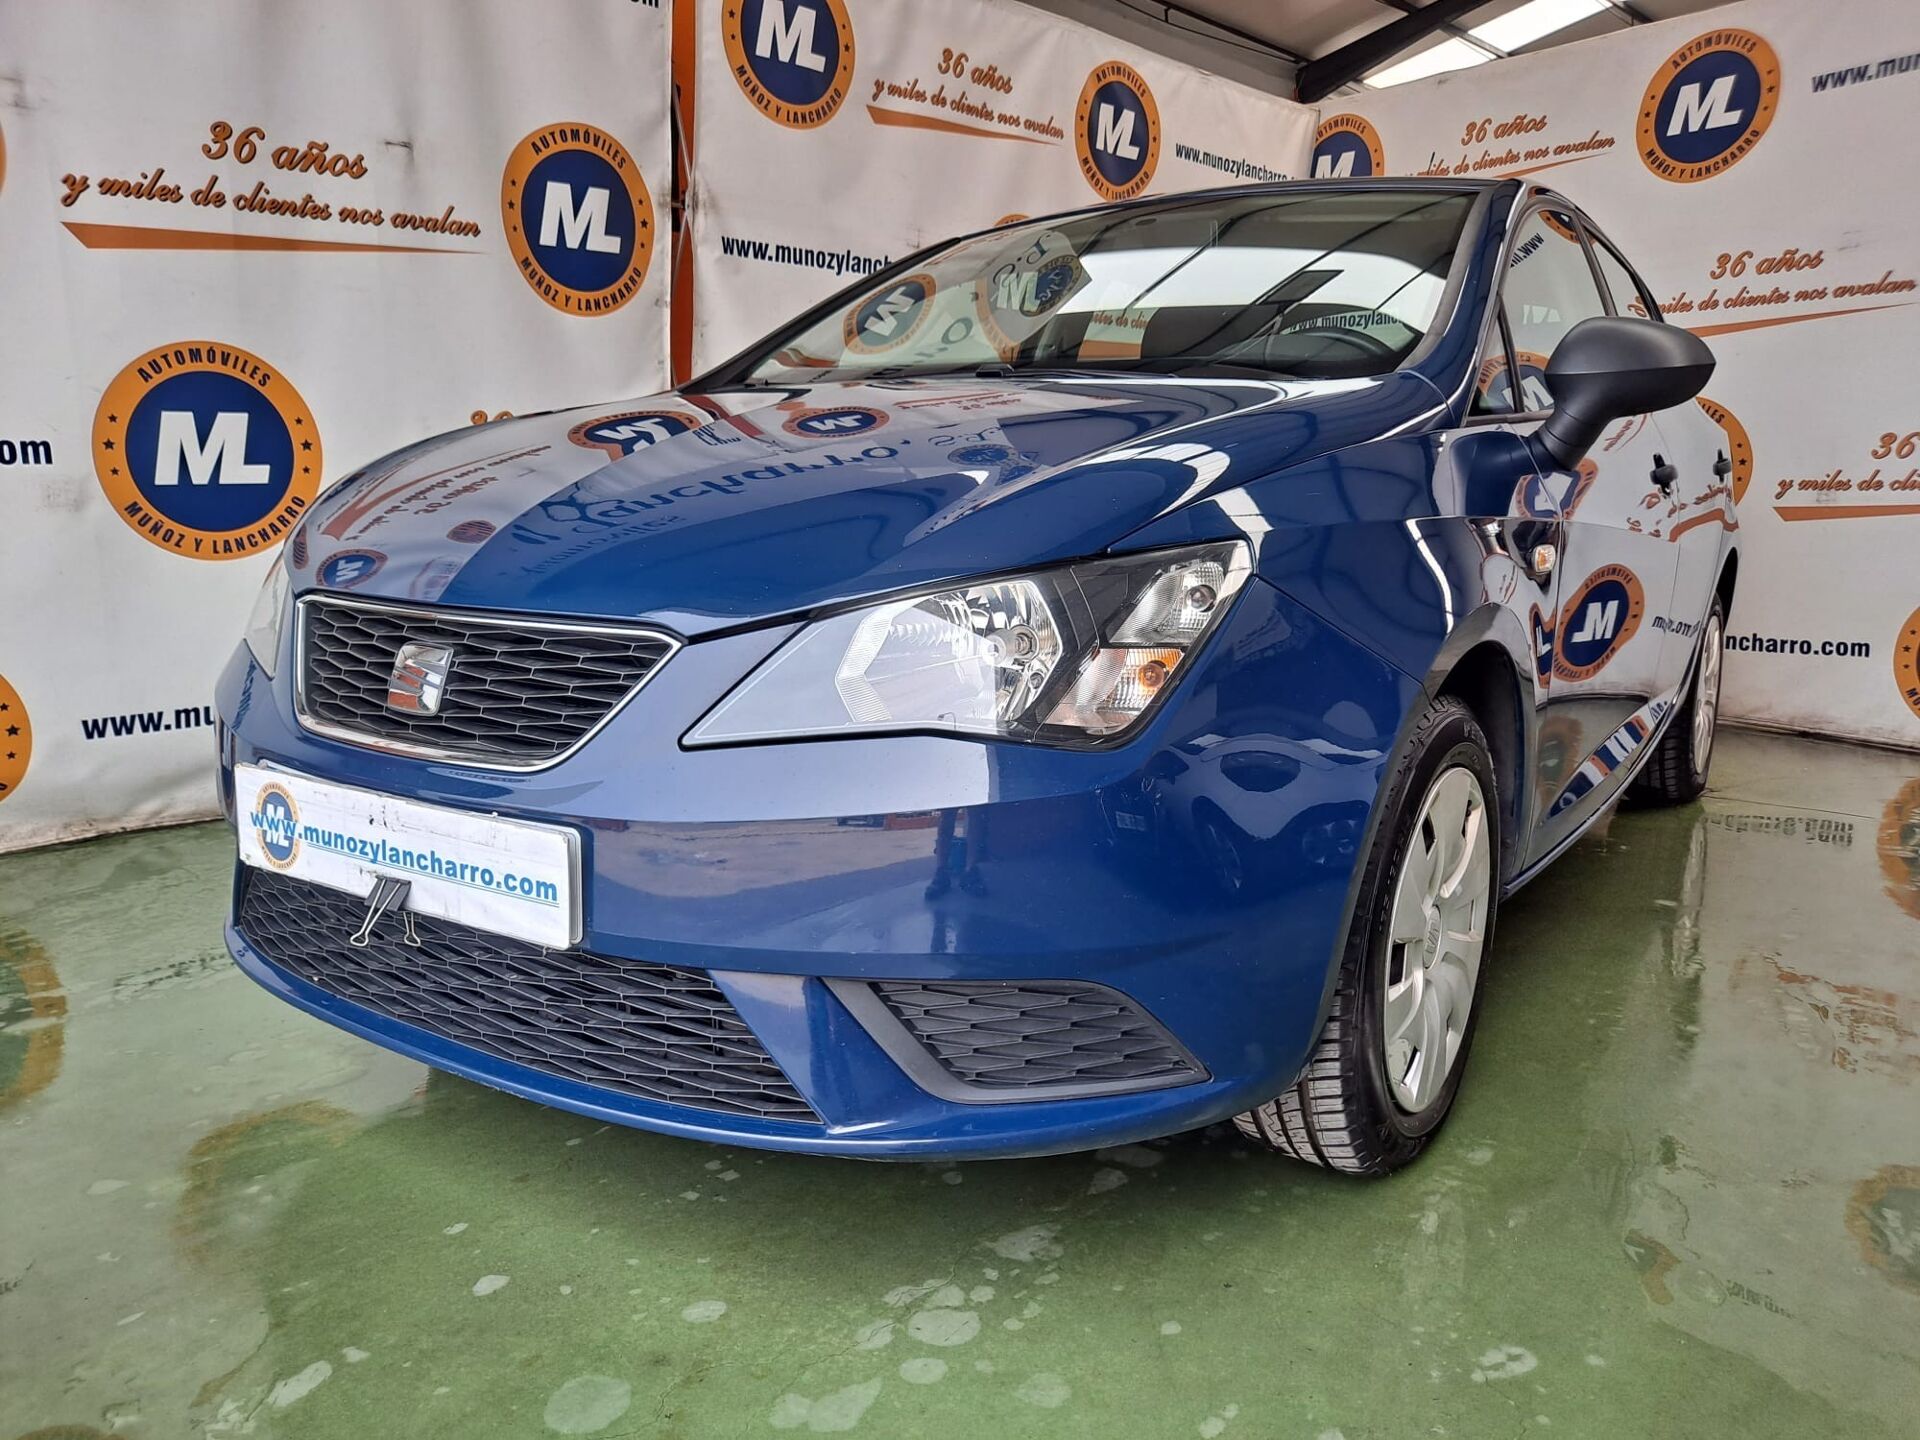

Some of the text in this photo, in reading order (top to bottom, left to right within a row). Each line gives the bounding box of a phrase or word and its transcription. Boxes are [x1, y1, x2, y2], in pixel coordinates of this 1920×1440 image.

[755, 0, 826, 73] ML
[937, 48, 1013, 94] 36 años
[775, 105, 782, 118] Y
[786, 87, 842, 124] LANCHARRO
[872, 78, 1065, 140] y miles de clientes nos avalan
[1095, 102, 1140, 161] ML
[1460, 113, 1548, 146] 36 años
[1666, 74, 1744, 137] ML
[201, 121, 368, 179] 36 años
[531, 128, 627, 170] AUTOMÓVILES
[1453, 154, 1469, 175] de
[1472, 150, 1521, 173] clientes
[1523, 146, 1550, 162] nos
[1553, 130, 1615, 156] avalan
[1678, 168, 1687, 179] Y
[1689, 129, 1760, 178] LANCHARRO
[60, 168, 481, 238] y miles de clientes nos avalan
[539, 180, 622, 255] ML
[521, 257, 642, 312] MUÑOZ Y LANCHARRO
[1710, 248, 1824, 280] 36 años
[1698, 289, 1719, 311] de
[1723, 287, 1789, 309] clientes
[1793, 287, 1828, 302] nos
[1832, 270, 1917, 299] avalan
[137, 346, 271, 387] AUTOMÓVILES
[154, 410, 271, 486] ML
[1871, 432, 1920, 459] 36
[1774, 469, 1920, 500] y miles de cli
[124, 495, 306, 554] MUÑOZ Y LANCHARRO
[250, 810, 558, 901] www.munozylancharro.com
